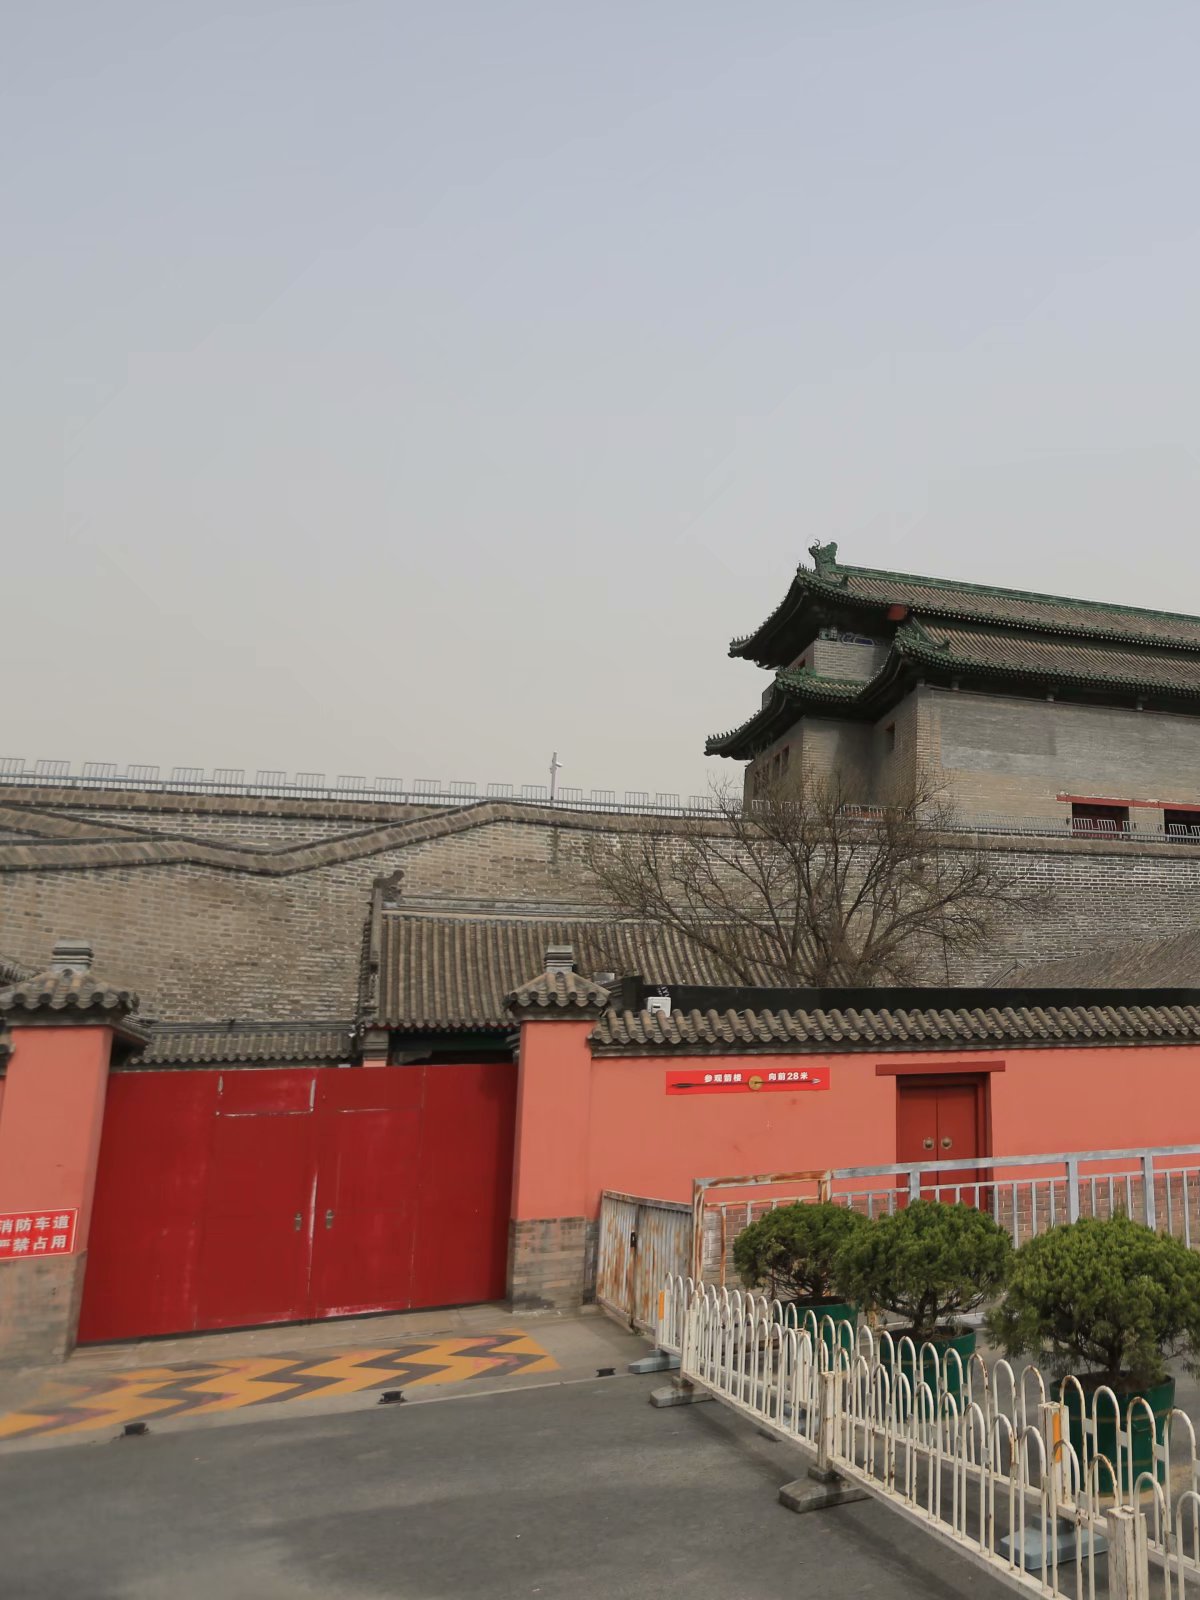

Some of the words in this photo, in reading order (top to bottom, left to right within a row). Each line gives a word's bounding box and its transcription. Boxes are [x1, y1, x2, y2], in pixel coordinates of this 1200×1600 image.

[704, 1074, 742, 1083] 参观箭楼
[768, 1072, 808, 1081] 向前28米
